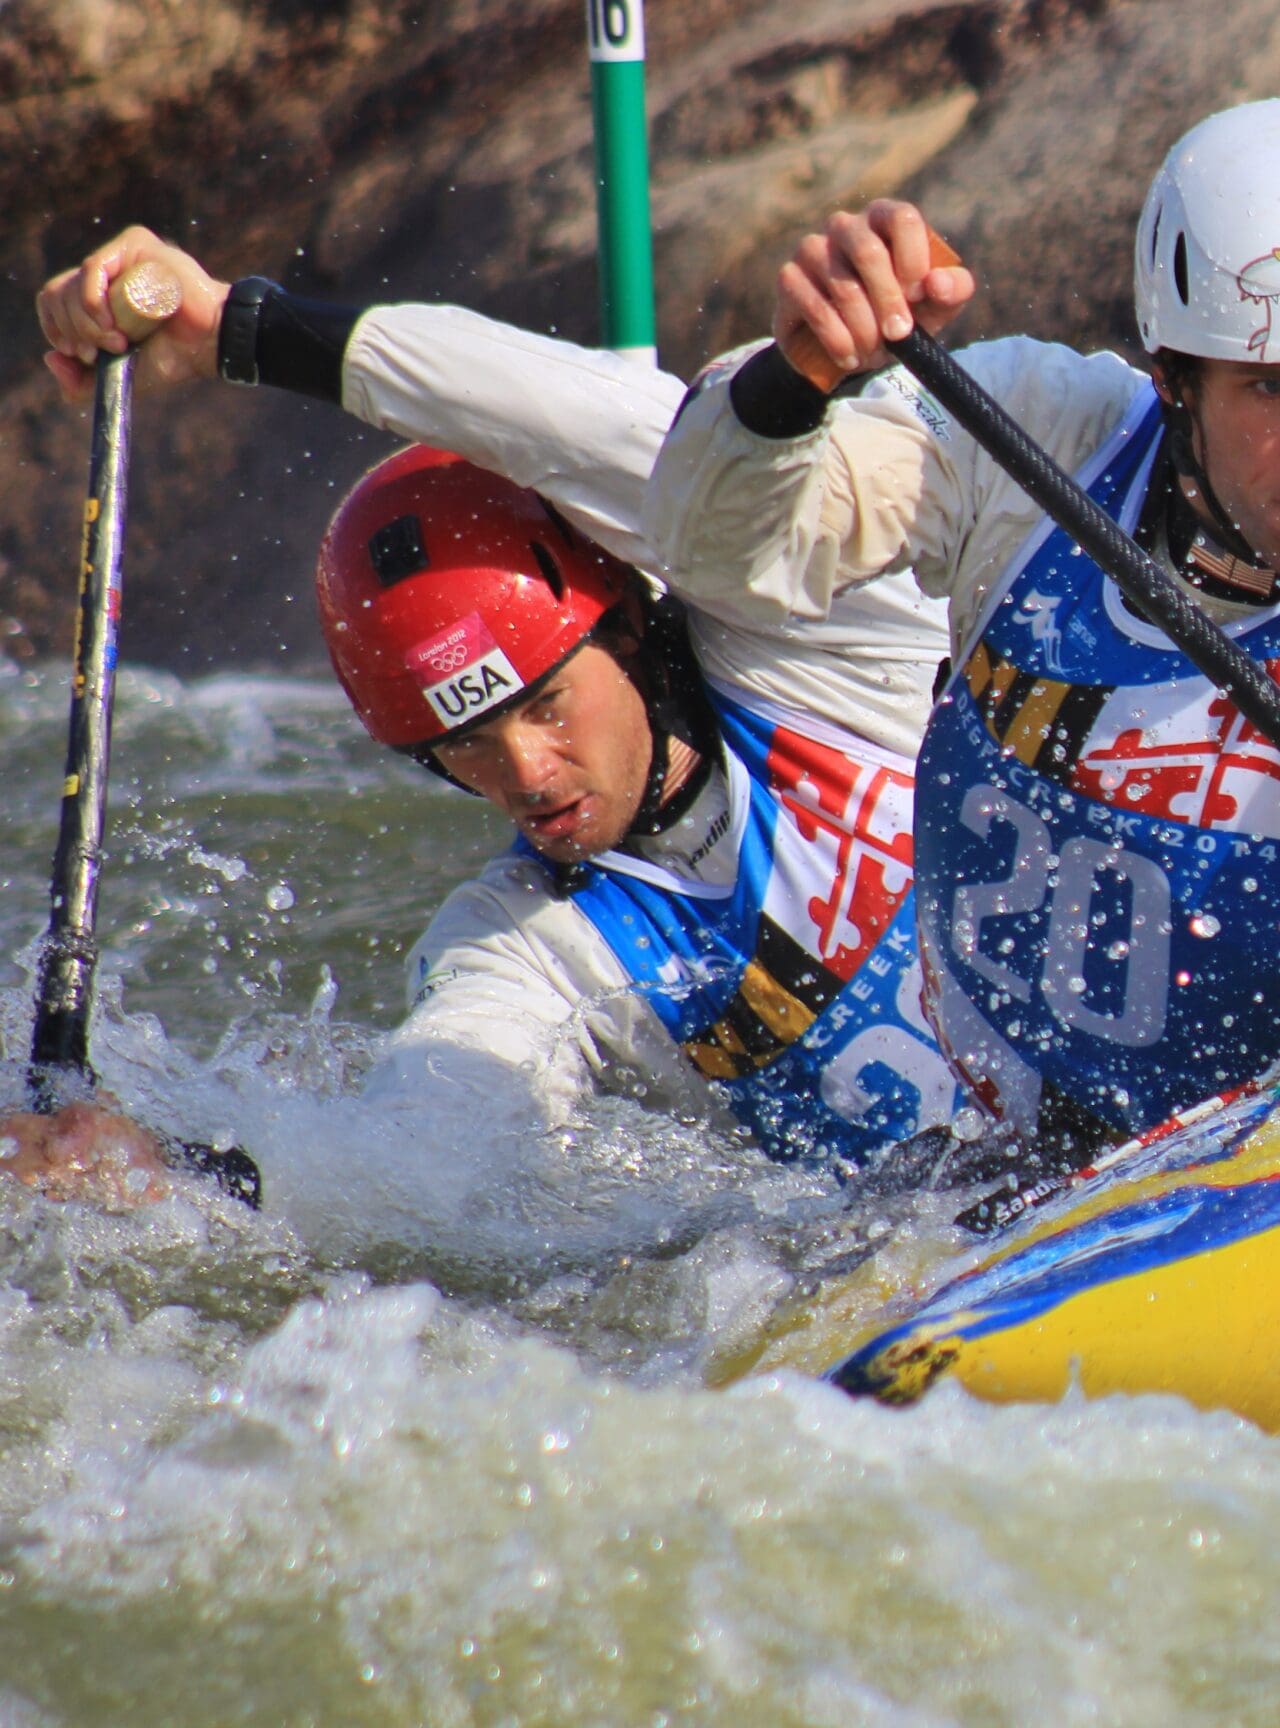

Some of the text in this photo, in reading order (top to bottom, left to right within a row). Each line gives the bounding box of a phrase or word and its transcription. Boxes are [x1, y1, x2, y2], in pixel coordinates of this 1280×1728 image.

[434, 664, 512, 717] USA
[951, 783, 1171, 1048] 20
[802, 926, 912, 1051] CREEK
